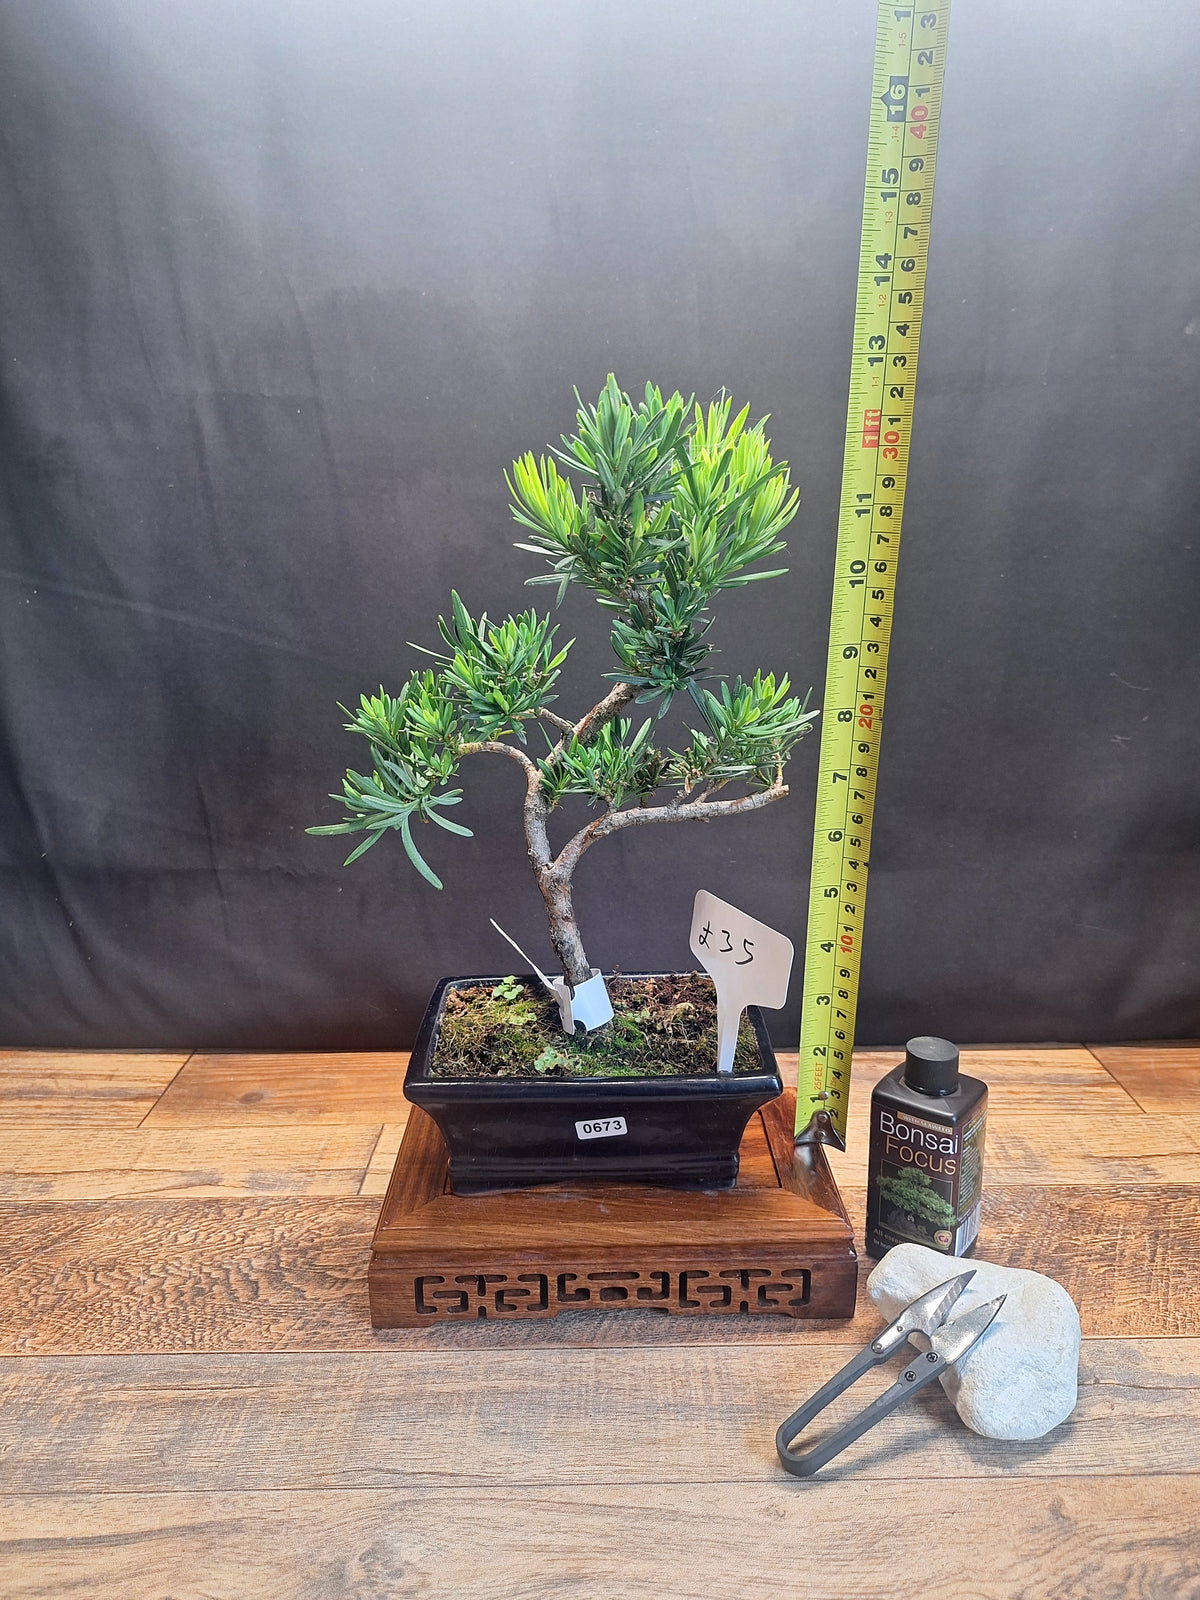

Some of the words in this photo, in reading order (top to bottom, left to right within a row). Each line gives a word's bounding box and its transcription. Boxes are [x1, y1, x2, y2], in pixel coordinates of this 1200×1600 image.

[920, 13, 936, 29] 3
[917, 50, 933, 66] 2
[916, 87, 931, 98] 1
[889, 84, 907, 115] 16
[910, 105, 928, 140] 40
[909, 157, 924, 172] 9
[880, 167, 899, 203] 15
[906, 192, 921, 206] 8
[903, 226, 918, 240] 7
[874, 253, 892, 287] 14
[901, 258, 915, 272] 6
[898, 291, 912, 305] 5
[896, 323, 910, 337] 4
[868, 335, 885, 367] 13
[893, 355, 907, 368] 3
[890, 386, 904, 399] 2
[865, 410, 881, 427] ft
[888, 417, 901, 426] 1
[864, 434, 878, 443] 1
[882, 431, 900, 459] 30
[882, 476, 896, 489] 9
[855, 493, 872, 518] 11
[879, 505, 893, 517] 8
[876, 534, 890, 545] 7
[874, 561, 887, 573] 6
[849, 559, 866, 589] 10
[872, 589, 884, 601] 5
[869, 616, 882, 627] 4
[842, 645, 858, 660] 9
[867, 643, 880, 654] 3
[864, 668, 877, 679] 2
[862, 693, 875, 701] 1
[837, 710, 853, 723] 8
[857, 704, 874, 730] 20
[857, 743, 870, 753] 9
[832, 772, 847, 784] 7
[856, 767, 868, 777] 8
[853, 791, 866, 801] 7
[851, 815, 864, 825] 6
[827, 830, 843, 842] 6
[849, 838, 862, 848] 5
[848, 860, 860, 870] 4
[823, 887, 838, 899] 5
[846, 882, 858, 893] 3
[844, 904, 856, 914] 2
[842, 924, 855, 932] 1
[820, 942, 835, 953] 4
[840, 935, 854, 954] 10
[839, 968, 851, 978] 9
[837, 989, 850, 999] 8
[816, 995, 831, 1006] 3
[836, 1010, 848, 1020] 7
[835, 1030, 847, 1040] 6
[812, 1046, 827, 1057] 2
[833, 1050, 844, 1060] 5
[813, 1062, 824, 1090] 25FEET
[832, 1069, 843, 1080] 4
[830, 1089, 841, 1099] 3
[582, 1120, 622, 1134] 0673
[879, 1111, 958, 1155] Bonsai
[885, 1135, 956, 1175] Focus
